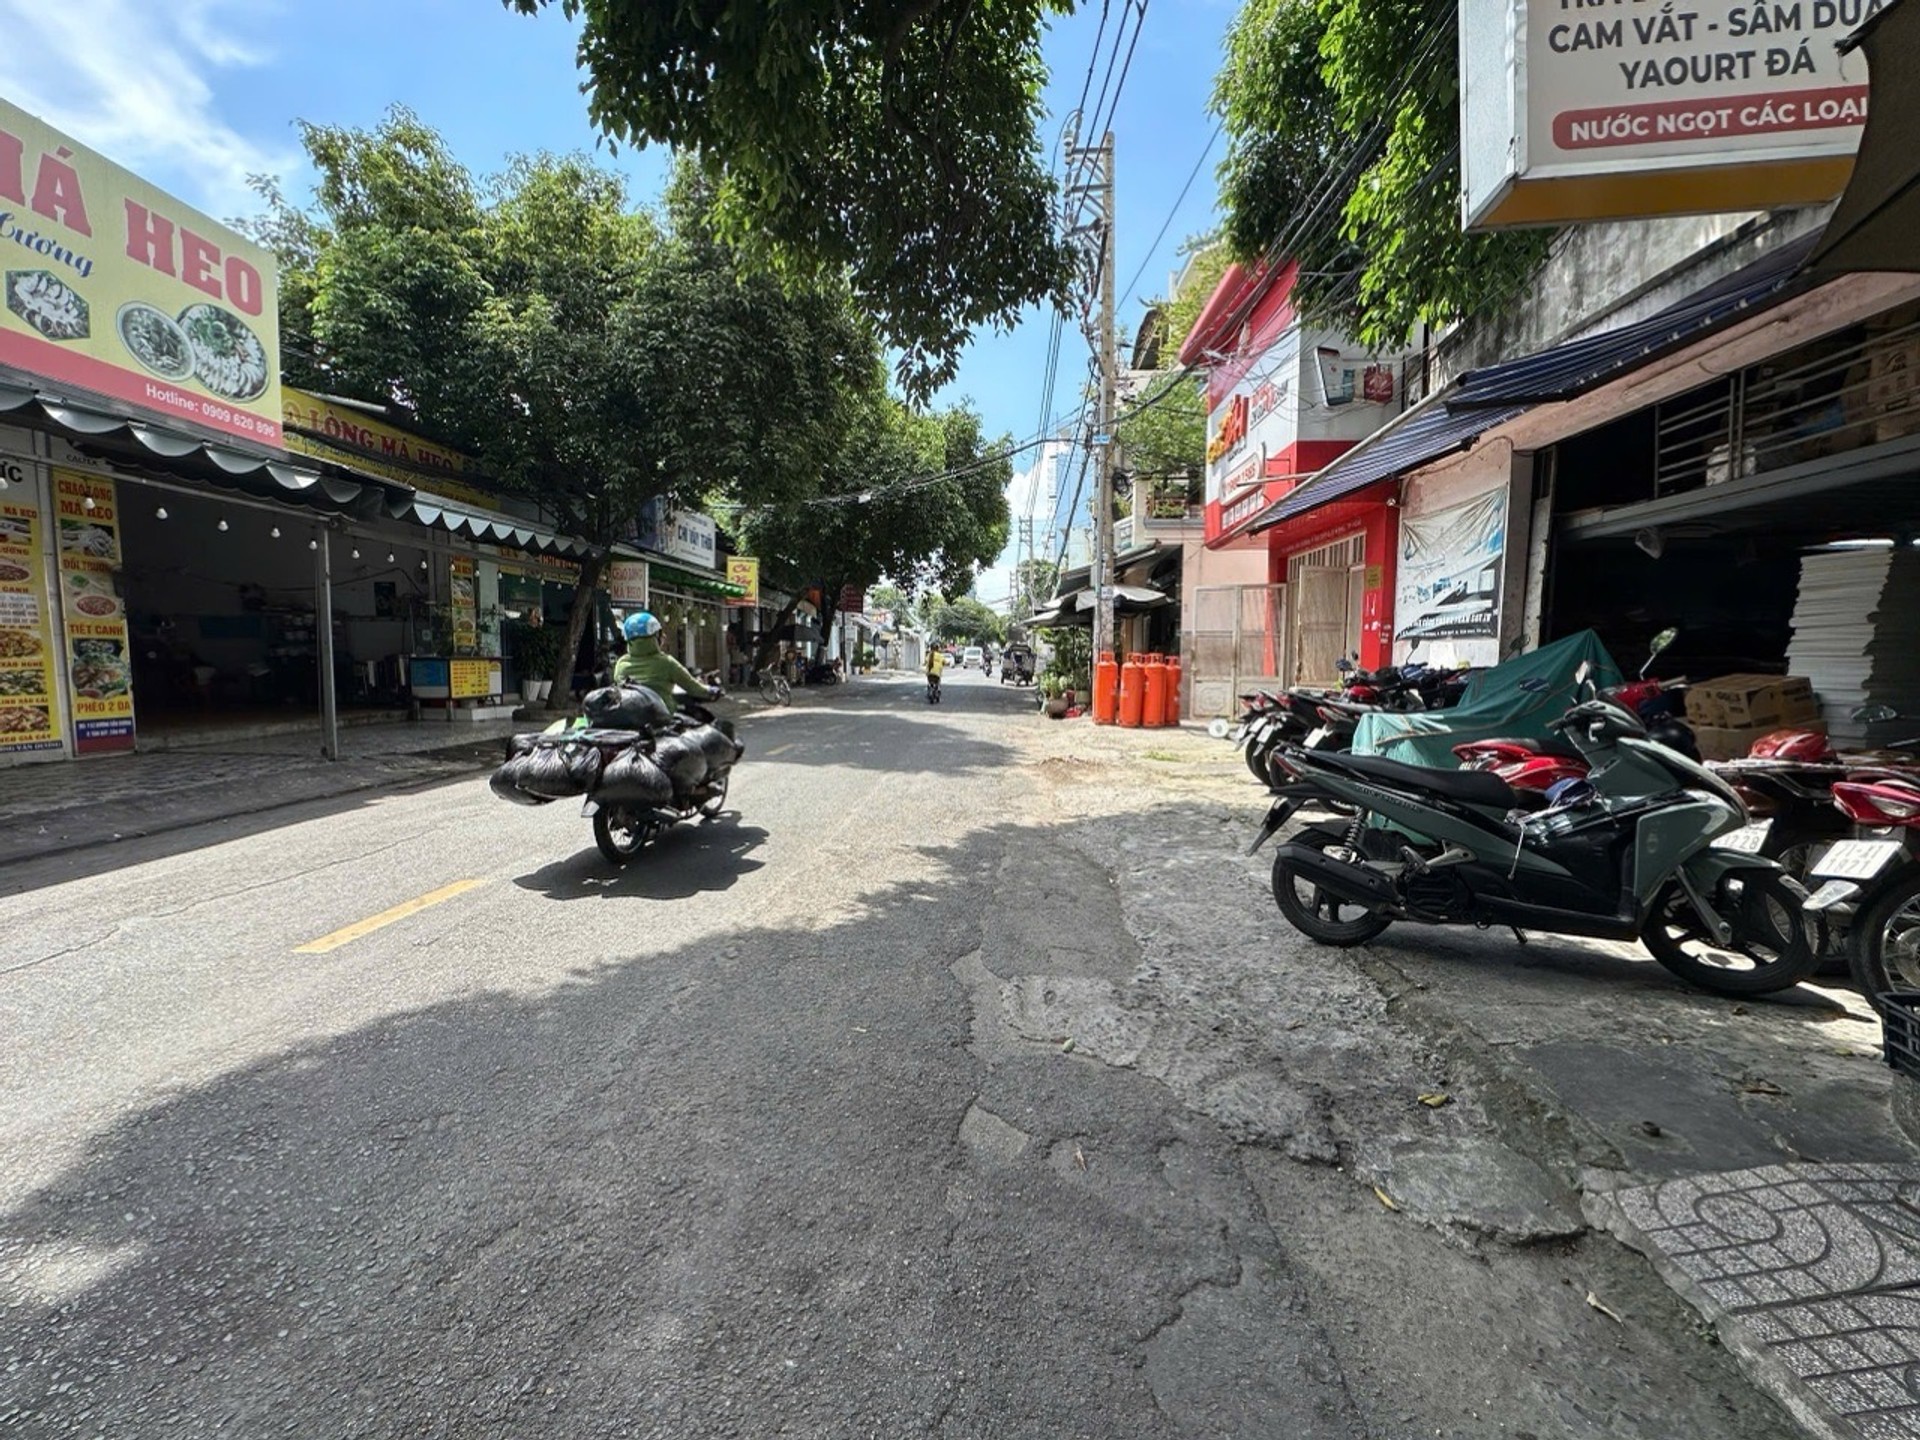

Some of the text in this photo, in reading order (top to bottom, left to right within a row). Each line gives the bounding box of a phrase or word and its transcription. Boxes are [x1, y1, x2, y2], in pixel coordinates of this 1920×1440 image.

[1549, 20, 1622, 53] CAM
[1632, 1, 1698, 45] VẮT
[1620, 37, 1816, 90] YAOURT ĐÁ
[1570, 97, 1867, 142] NƯỚC NGỌT CÁC LOẠI
[0, 130, 263, 317] Á HEO
[145, 383, 199, 413] Hotline:
[202, 402, 231, 423] 0909
[308, 409, 374, 449] LÒNG
[95, 625, 124, 636] CANH
[108, 702, 115, 712] 2
